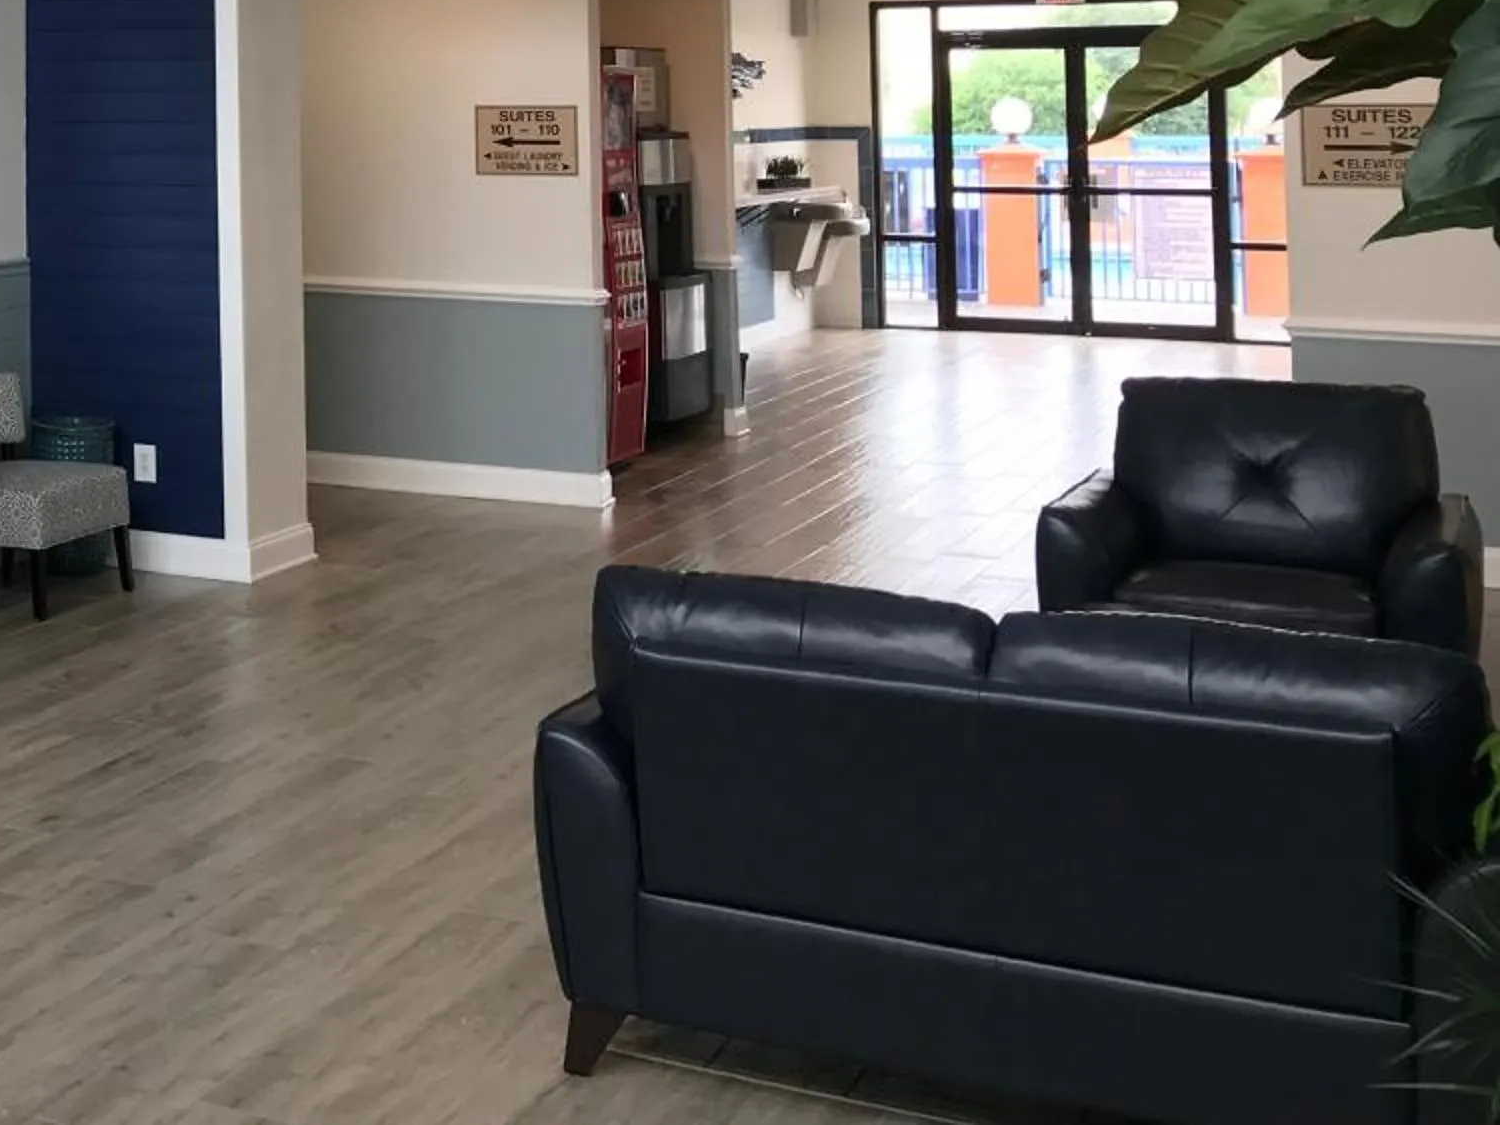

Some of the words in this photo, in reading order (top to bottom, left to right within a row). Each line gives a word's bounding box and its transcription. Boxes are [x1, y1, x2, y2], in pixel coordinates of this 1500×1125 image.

[499, 110, 555, 122] SUITES
[1332, 108, 1412, 123] SUITES
[490, 124, 511, 135] 101
[539, 124, 560, 135] 110
[1323, 126, 1349, 139] 111
[1388, 126, 1420, 139] 122
